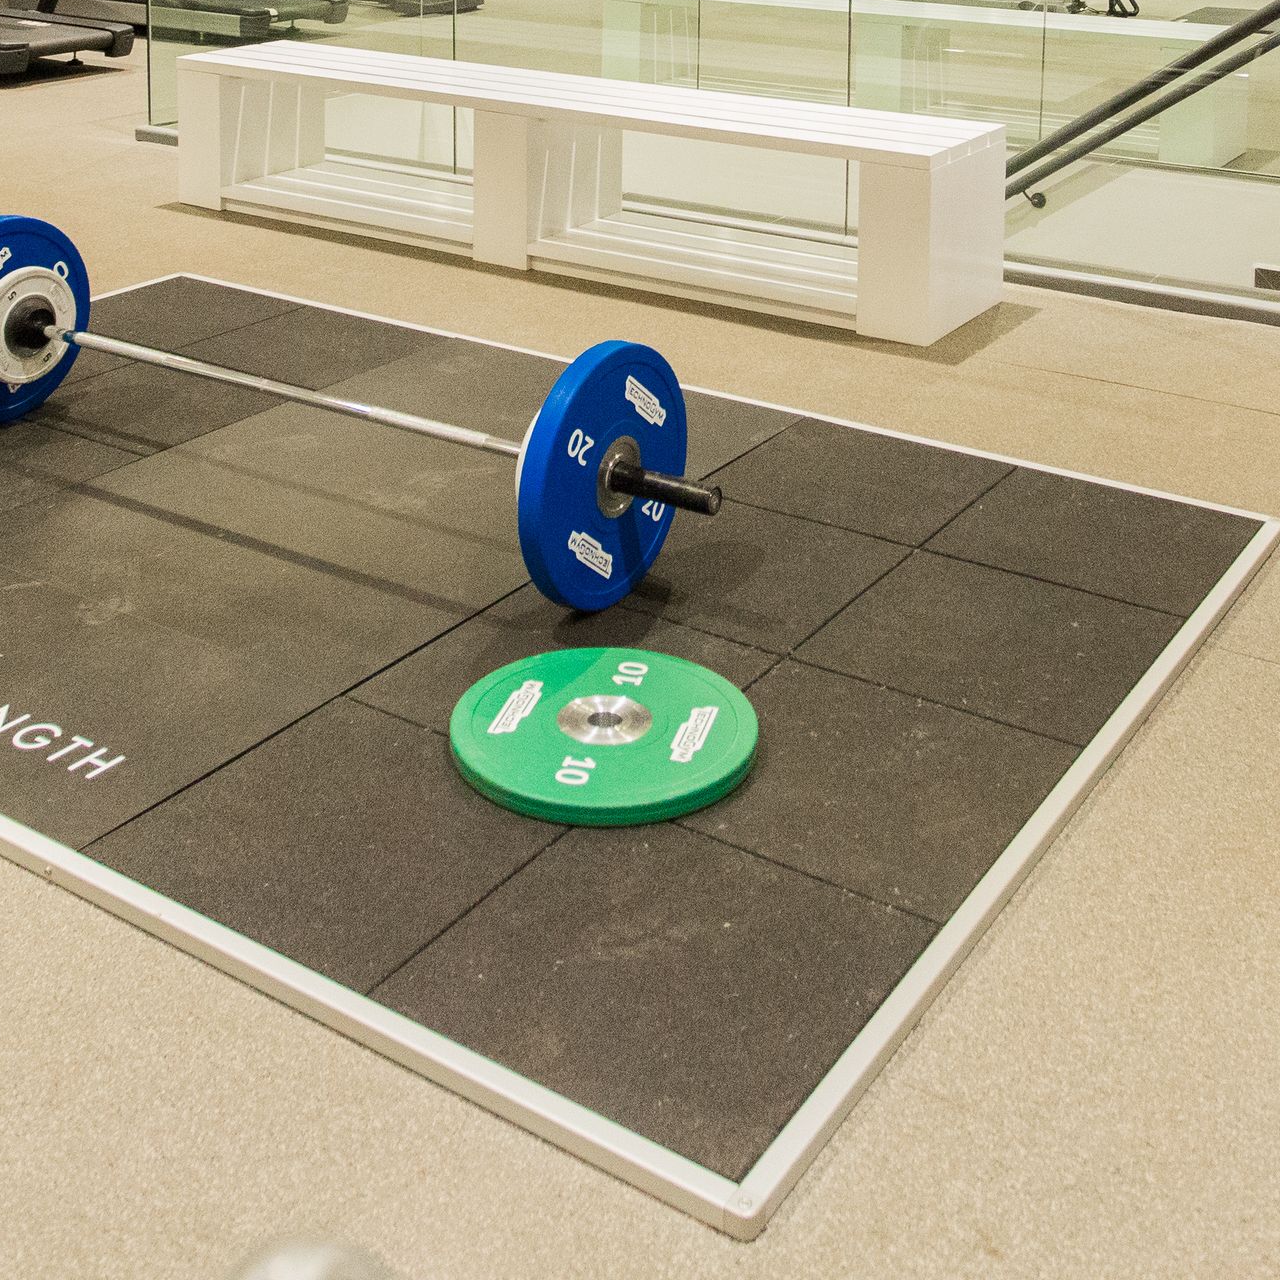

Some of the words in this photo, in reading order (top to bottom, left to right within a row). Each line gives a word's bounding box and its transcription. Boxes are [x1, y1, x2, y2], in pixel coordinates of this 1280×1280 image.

[7, 290, 17, 301] 5
[567, 428, 595, 467] 20
[612, 661, 649, 687] 10
[555, 755, 597, 786] 10
